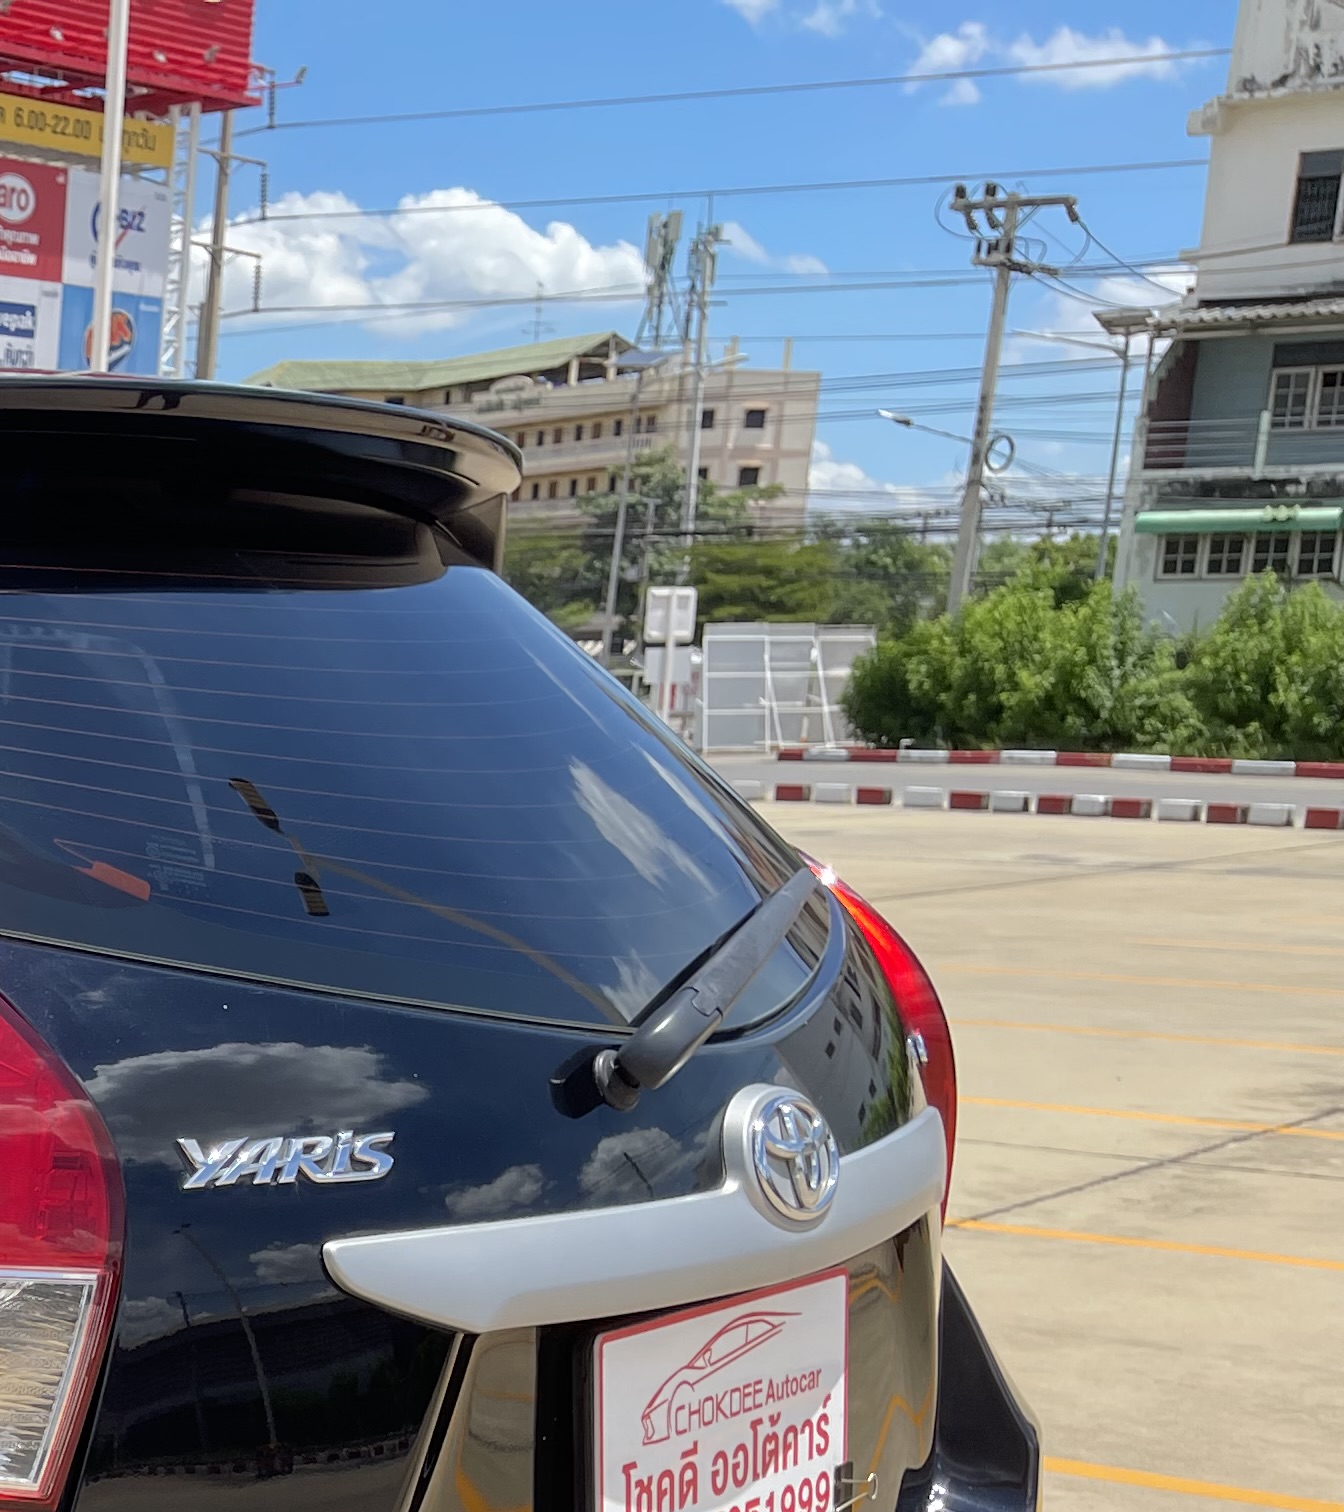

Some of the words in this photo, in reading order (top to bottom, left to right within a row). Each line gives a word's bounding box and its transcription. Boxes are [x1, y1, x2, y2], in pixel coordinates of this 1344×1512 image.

[14, 106, 92, 140] 6.00-22.00
[176, 1129, 396, 1191] YARIS
[674, 1378, 764, 1437] CHOKDEE
[765, 1367, 822, 1406] Autocar
[711, 1392, 831, 1497] ออโต้คาร์
